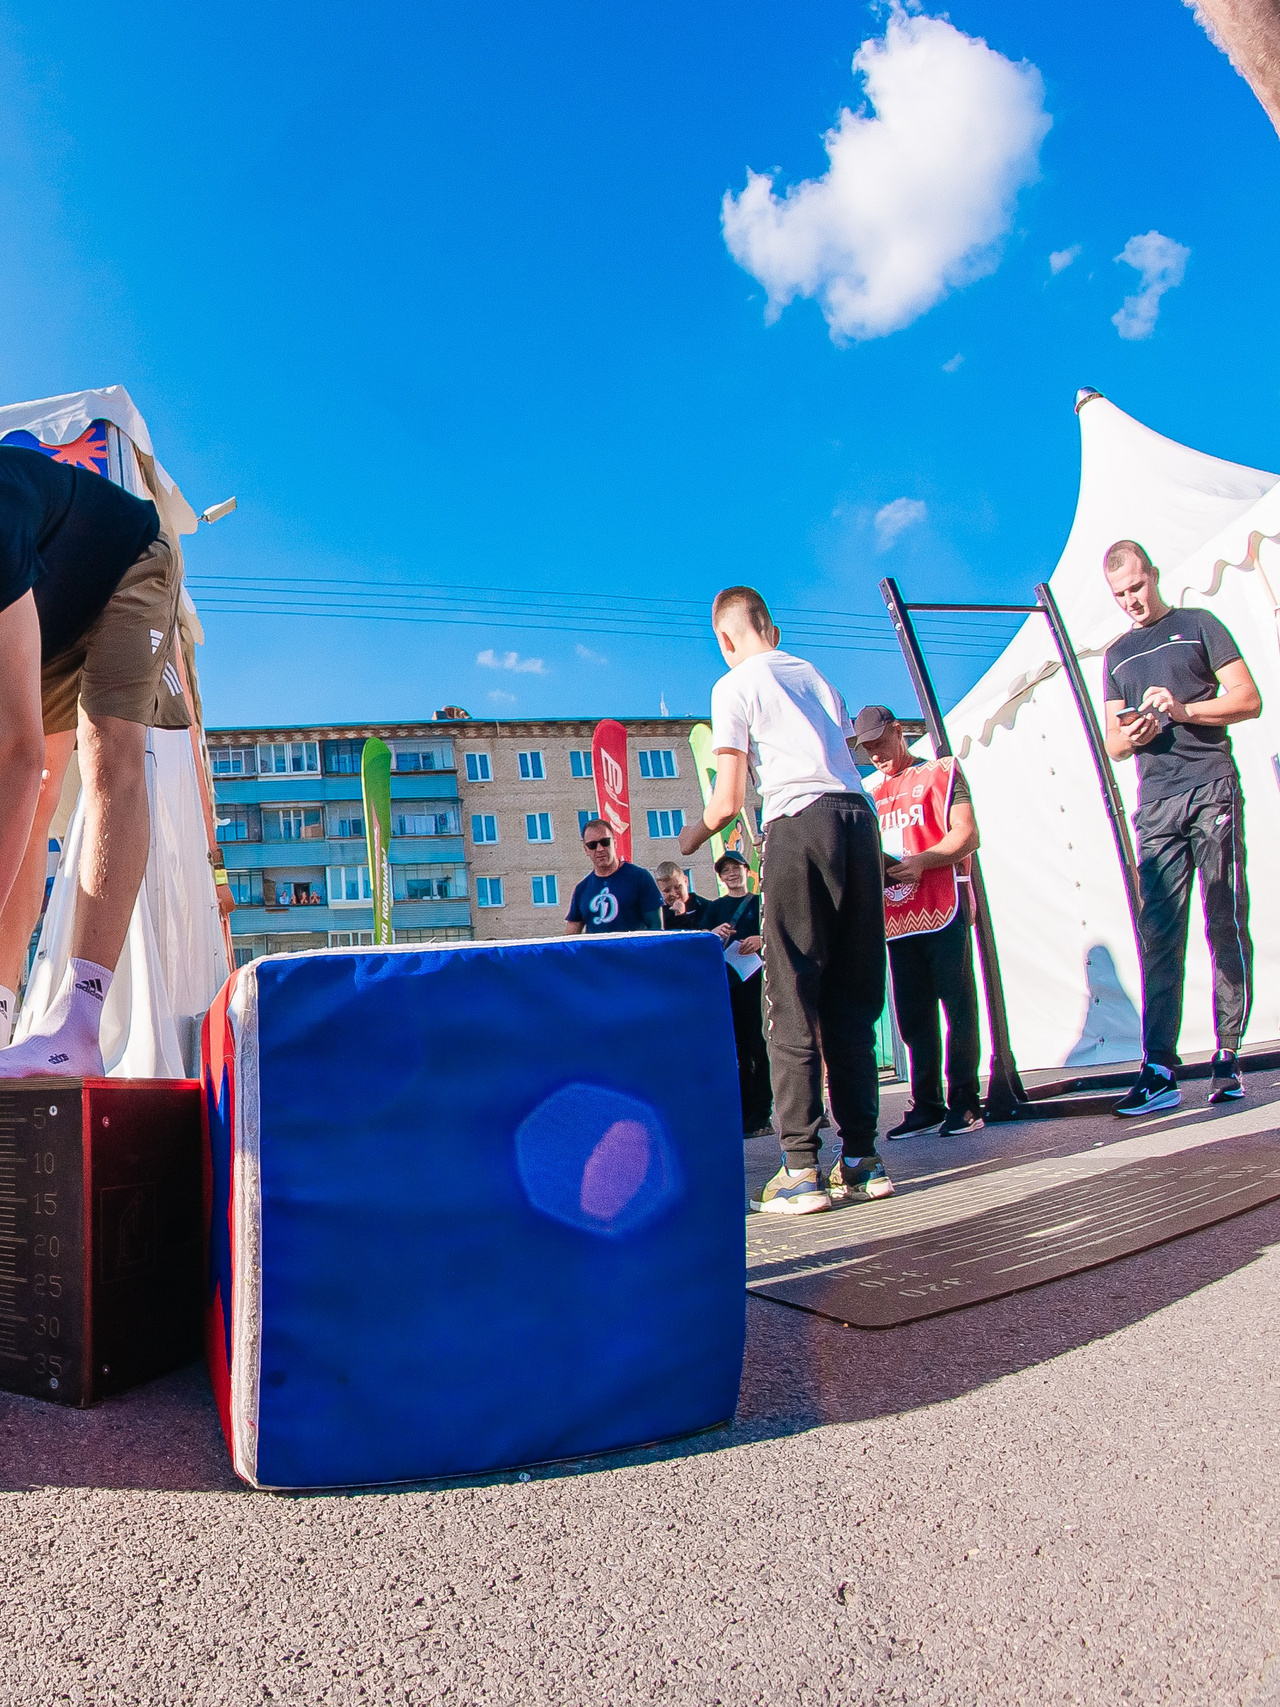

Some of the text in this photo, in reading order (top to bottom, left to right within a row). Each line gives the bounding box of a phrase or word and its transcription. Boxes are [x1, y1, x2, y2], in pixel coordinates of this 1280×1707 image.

[32, 1107, 47, 1129] 5
[34, 1152, 54, 1175] 10
[34, 1193, 57, 1216] 15
[34, 1234, 60, 1258] 20
[34, 1273, 62, 1298] 25
[34, 1314, 60, 1338] 30
[34, 1352, 62, 1377] 35
